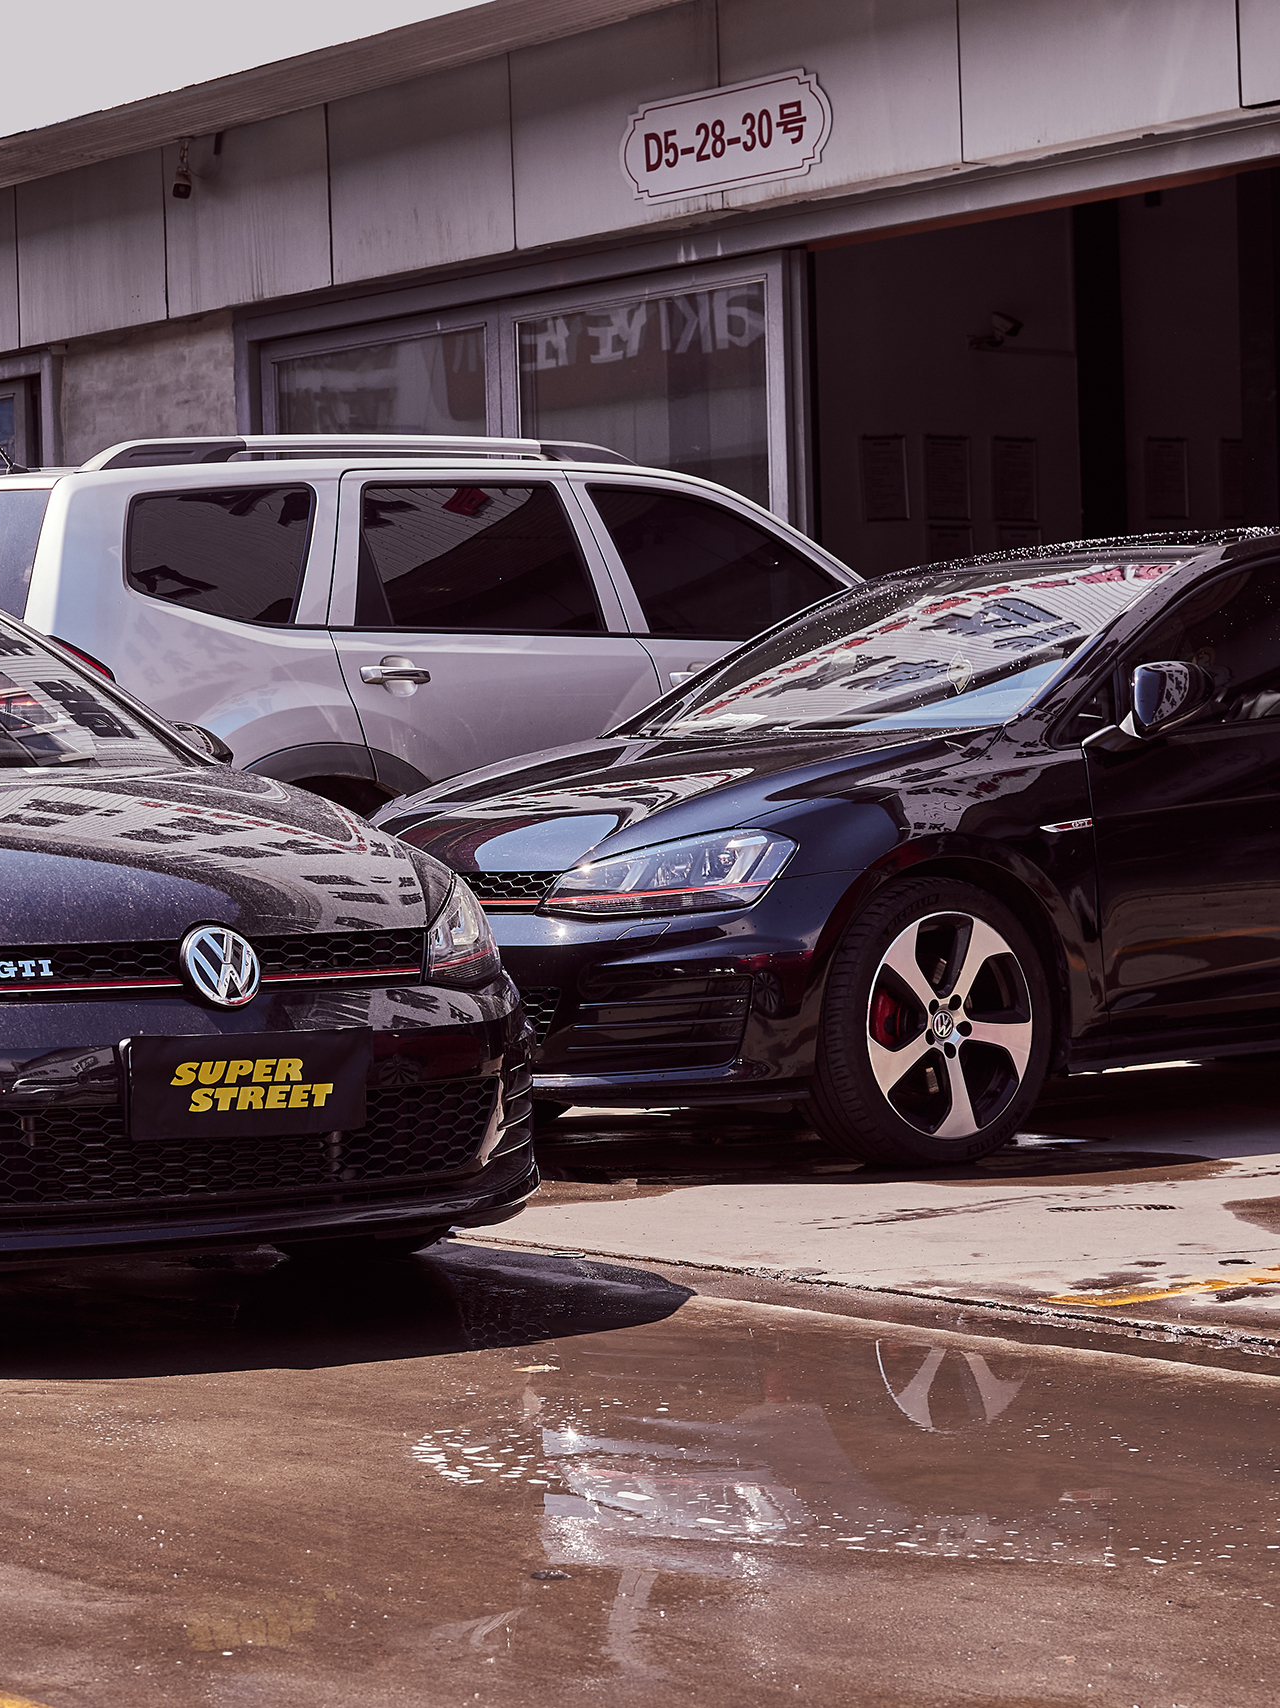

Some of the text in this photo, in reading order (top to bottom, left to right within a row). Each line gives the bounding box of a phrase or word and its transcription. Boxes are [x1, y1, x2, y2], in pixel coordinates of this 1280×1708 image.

[643, 99, 807, 173] D5-28-30号
[170, 1057, 304, 1086] SUPER
[188, 1082, 334, 1113] STREET
